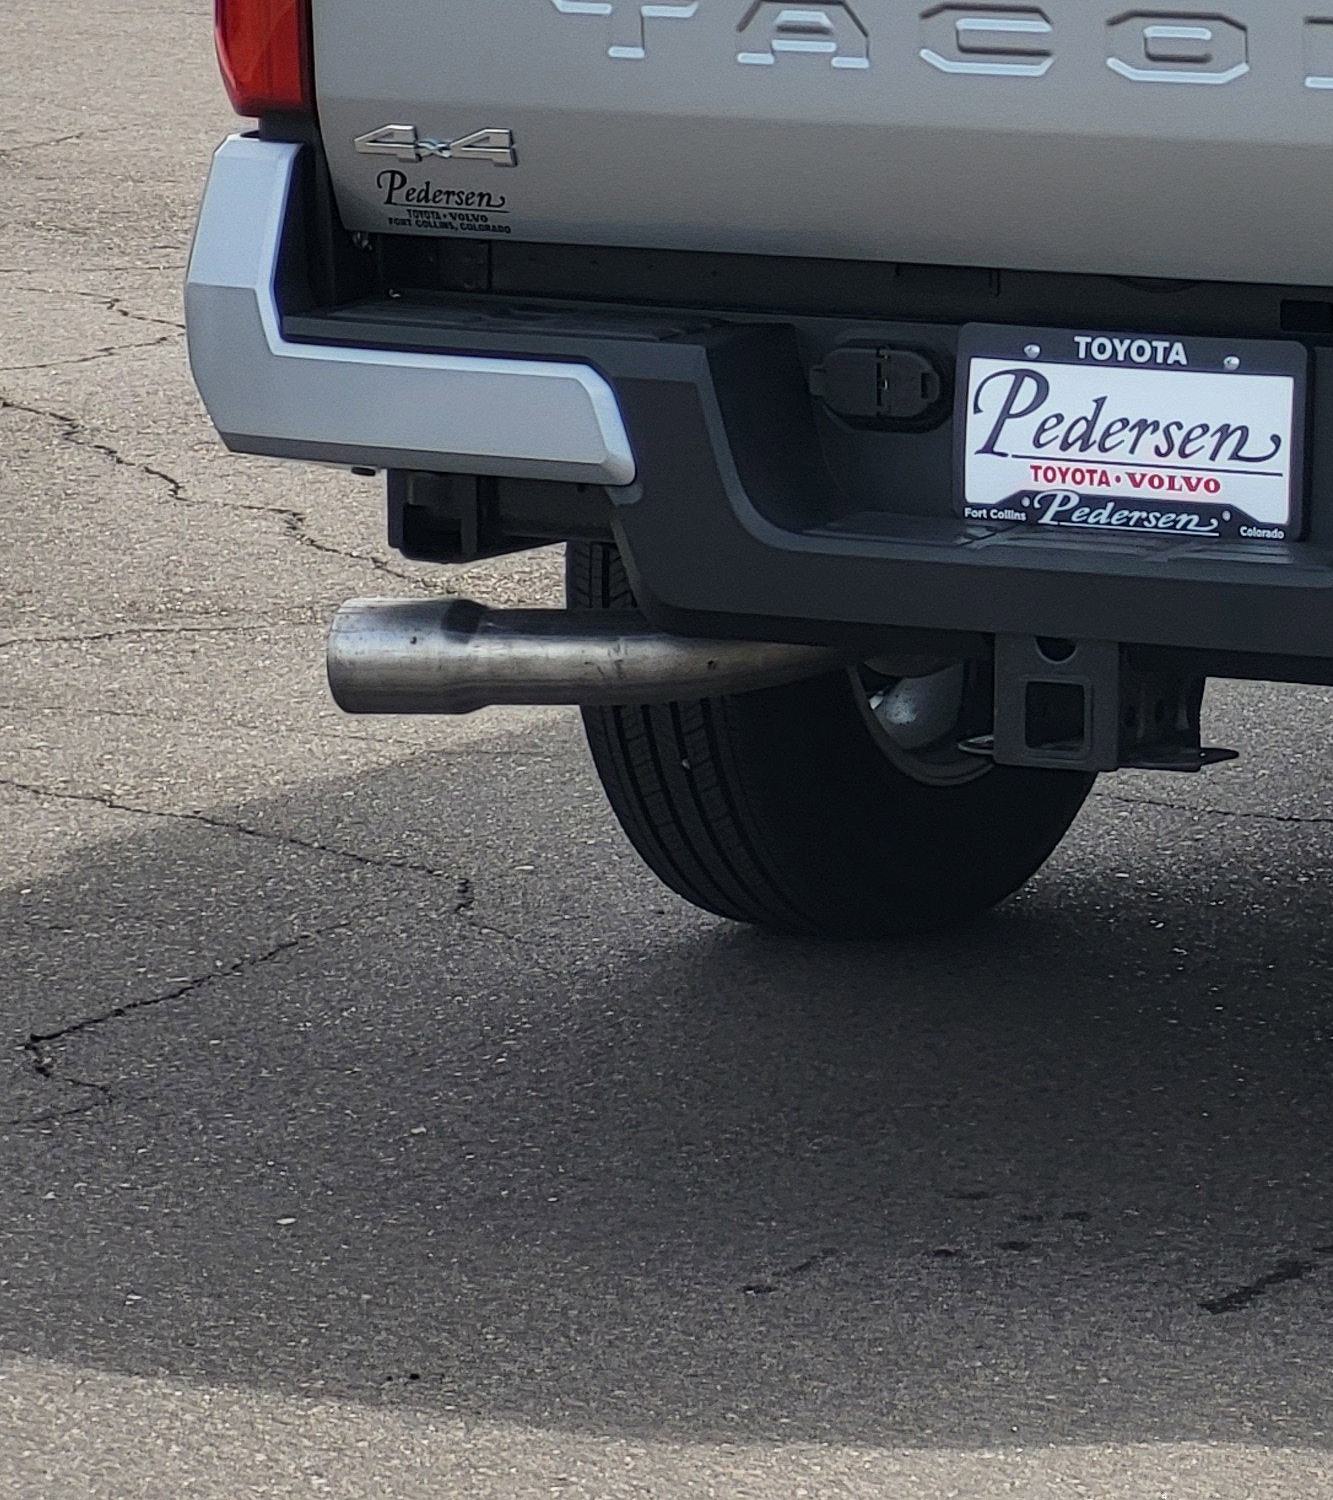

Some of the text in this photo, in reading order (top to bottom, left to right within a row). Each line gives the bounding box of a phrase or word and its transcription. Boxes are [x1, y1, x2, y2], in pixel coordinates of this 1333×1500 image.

[377, 169, 506, 209] Pedersen
[388, 217, 412, 227] FORT
[460, 222, 512, 234] COLORADO
[406, 208, 488, 223] TOYOTA VOLVO
[1074, 335, 1188, 366] TOYOTA
[973, 368, 1282, 463] Pedersen
[1030, 465, 1221, 494] TOYOTA VOLVO
[964, 490, 1285, 540] Fort Collins Pedersen Colorado
